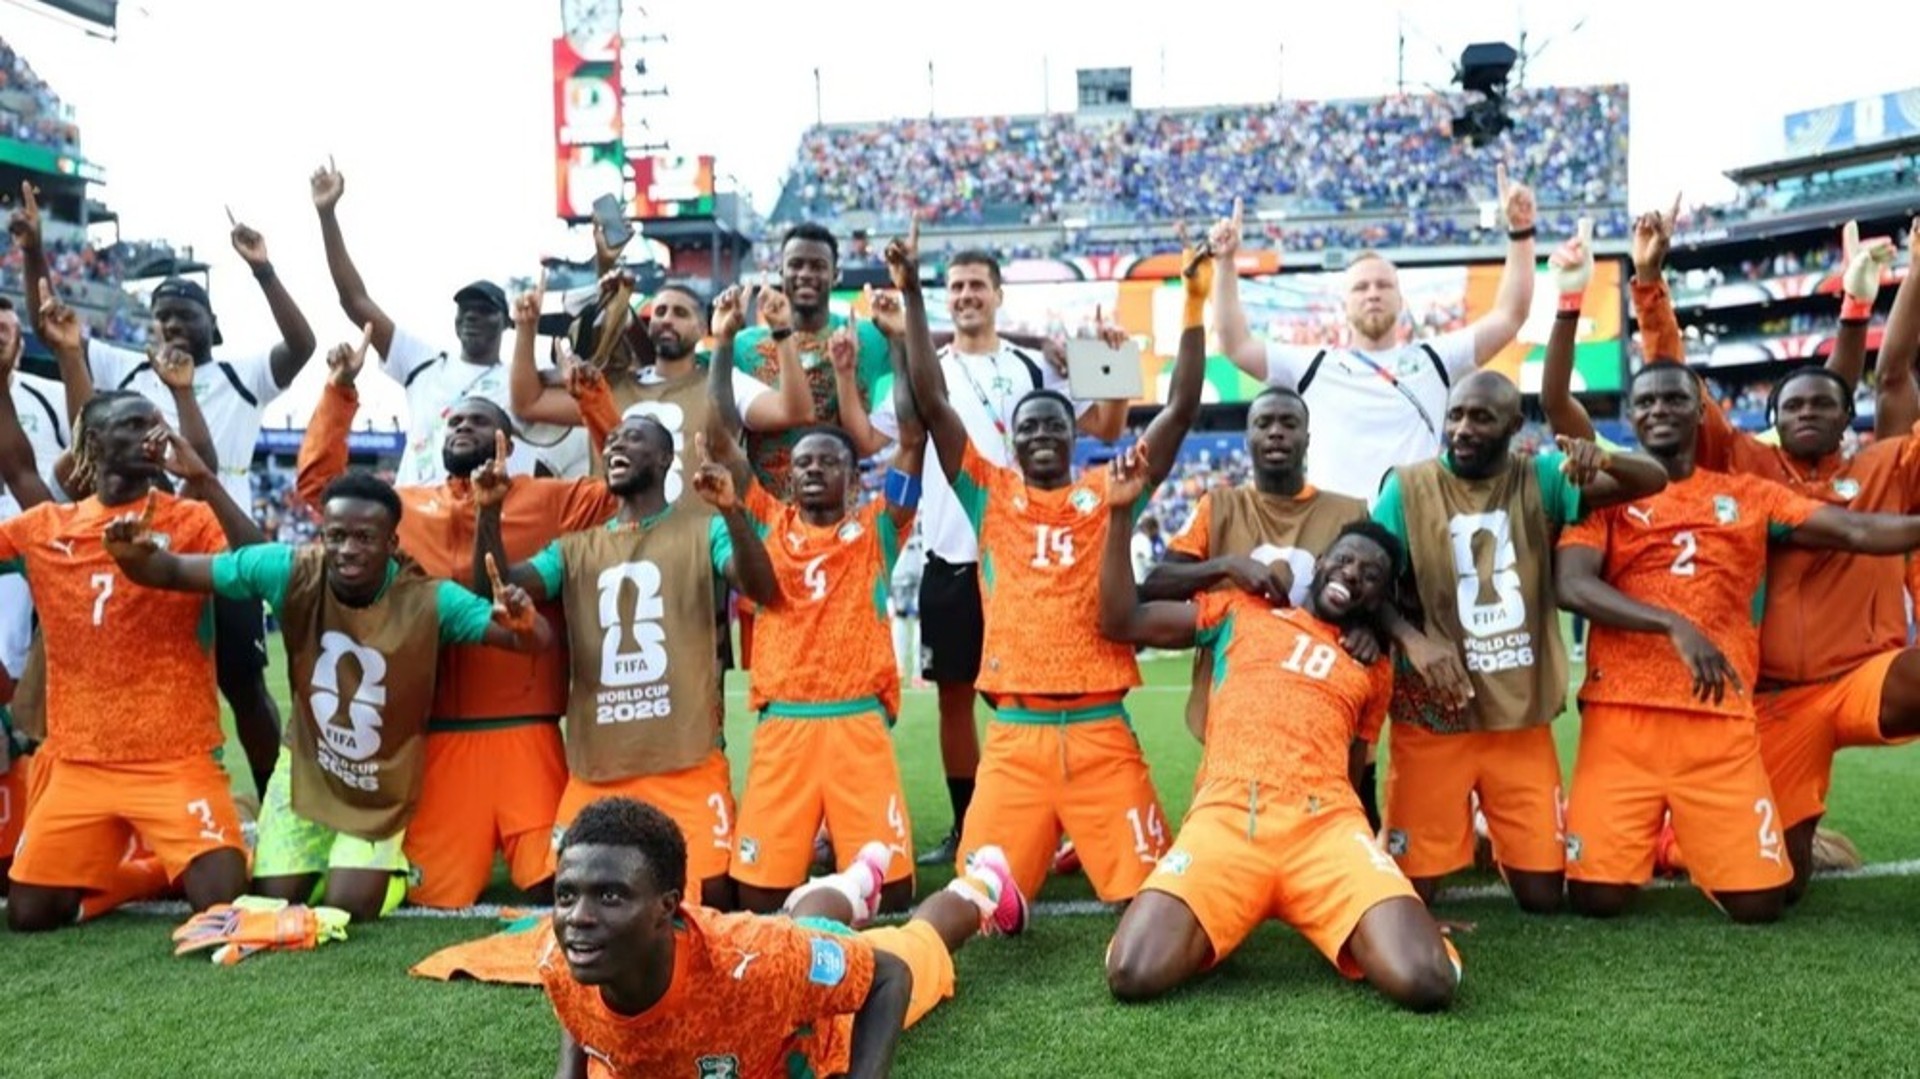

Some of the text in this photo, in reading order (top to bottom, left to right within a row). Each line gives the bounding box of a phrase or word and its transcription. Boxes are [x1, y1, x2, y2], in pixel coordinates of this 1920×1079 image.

[1031, 523, 1076, 569] 14
[1670, 531, 1697, 577] 2
[804, 551, 828, 601] 4
[91, 573, 114, 627] 7
[1473, 609, 1507, 626] FIFA
[1281, 633, 1338, 679] 18
[1464, 632, 1531, 651] WORLD CUP
[1466, 647, 1534, 674] 2026
[614, 659, 648, 675] FIFA
[596, 697, 671, 725] 2026
[597, 684, 669, 704] WORLD CUP
[326, 728, 357, 749] FIFA
[318, 750, 379, 791] 2026
[707, 792, 729, 835] 3
[888, 793, 905, 839] 4
[1126, 803, 1165, 854] 14
[1754, 798, 1777, 846] 2
